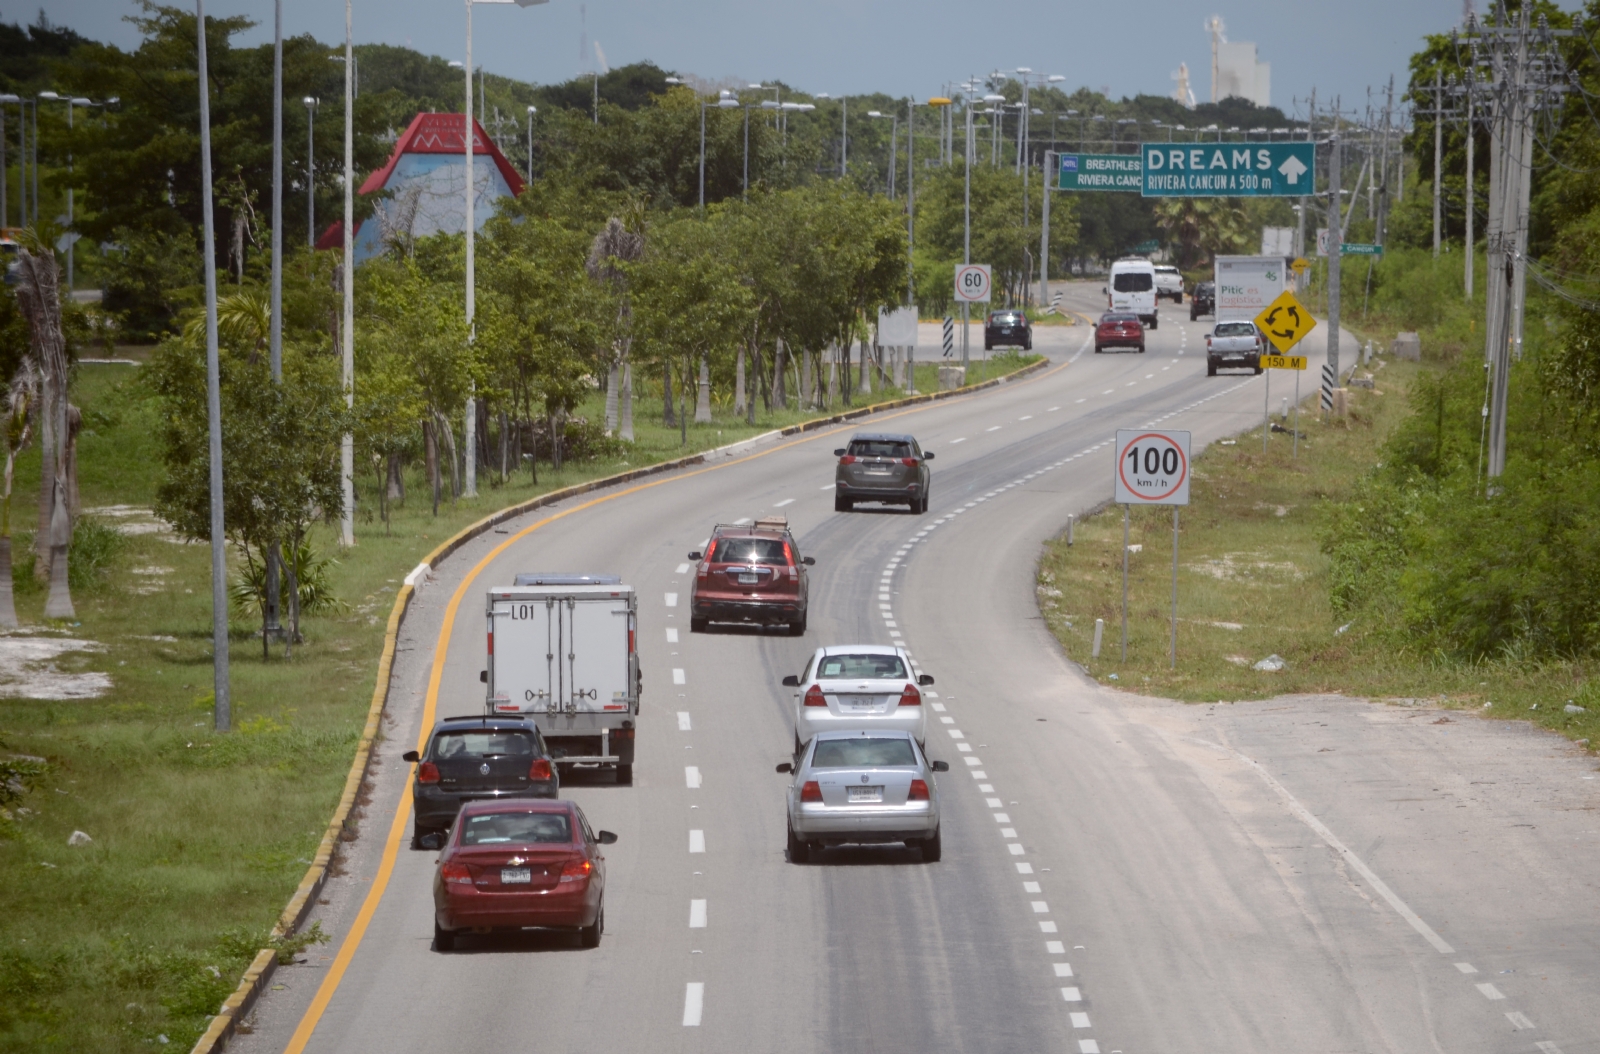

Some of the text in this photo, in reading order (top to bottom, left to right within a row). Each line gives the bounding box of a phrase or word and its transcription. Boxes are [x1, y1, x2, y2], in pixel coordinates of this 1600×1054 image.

[1086, 159, 1142, 171] BREATHLES
[1148, 149, 1271, 170] DREAMS
[1077, 174, 1115, 186] RIVIERA
[1148, 175, 1271, 189] RIVIERA CANCUN A 500 m
[964, 272, 982, 287] 60
[1221, 285, 1259, 295] Pitic es
[1267, 358, 1300, 367] 150 M
[1127, 447, 1179, 475] 100
